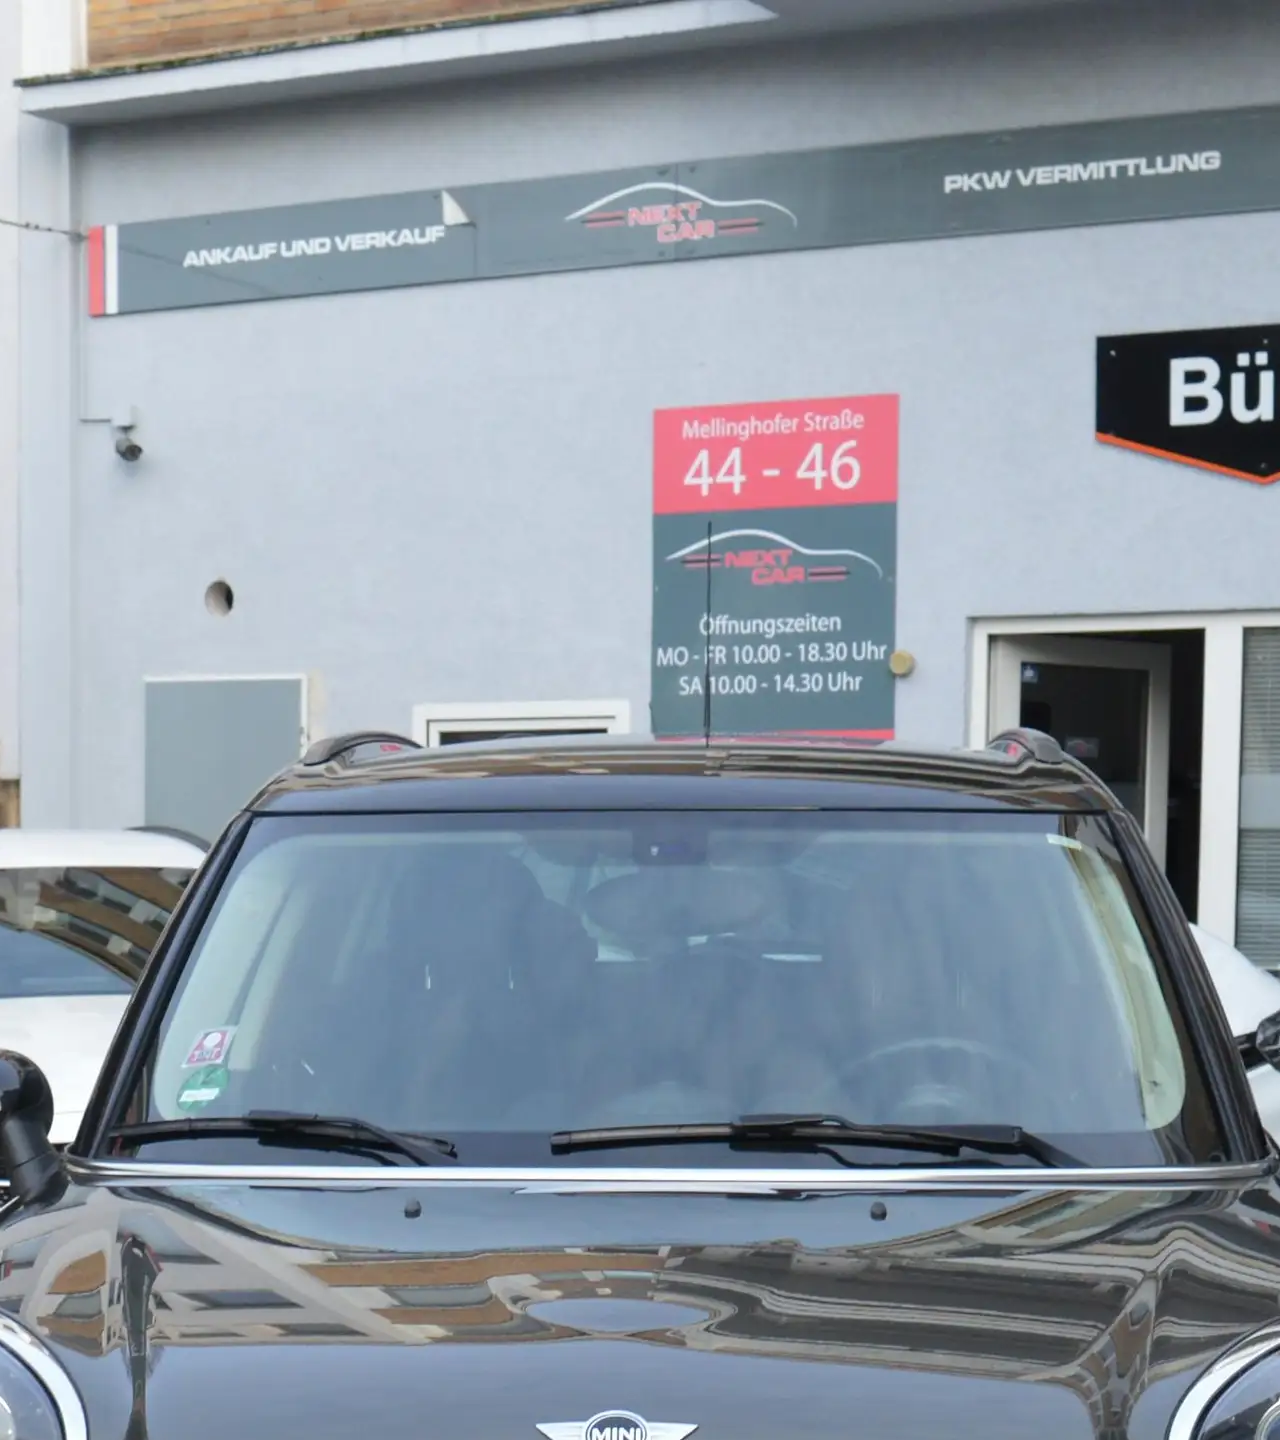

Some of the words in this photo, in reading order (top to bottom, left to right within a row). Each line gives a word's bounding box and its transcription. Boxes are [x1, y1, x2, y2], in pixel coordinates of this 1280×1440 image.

[943, 169, 1011, 194] PKW
[1016, 150, 1221, 187] VERMITTLUNG
[627, 200, 702, 227] NEXT
[656, 219, 715, 243] CAR
[183, 243, 277, 268] ANKAUF
[280, 237, 331, 258] UND
[334, 225, 445, 252] VERKAUF
[682, 412, 799, 442] Mellinghofer
[803, 408, 865, 432] Straße
[683, 446, 747, 497] 44
[796, 439, 861, 491] 46
[724, 548, 793, 568] NEXT
[751, 566, 805, 586] CAR
[698, 612, 842, 639] Öffnungszeiten
[655, 646, 689, 667] MO
[703, 645, 727, 665] FR
[732, 644, 781, 664] 10.00
[797, 642, 847, 662] 18.30
[851, 640, 888, 660] Uhr
[678, 675, 703, 696] SA
[707, 674, 757, 694] 10.00
[773, 672, 824, 693] 14.30
[827, 671, 864, 691] Uhr
